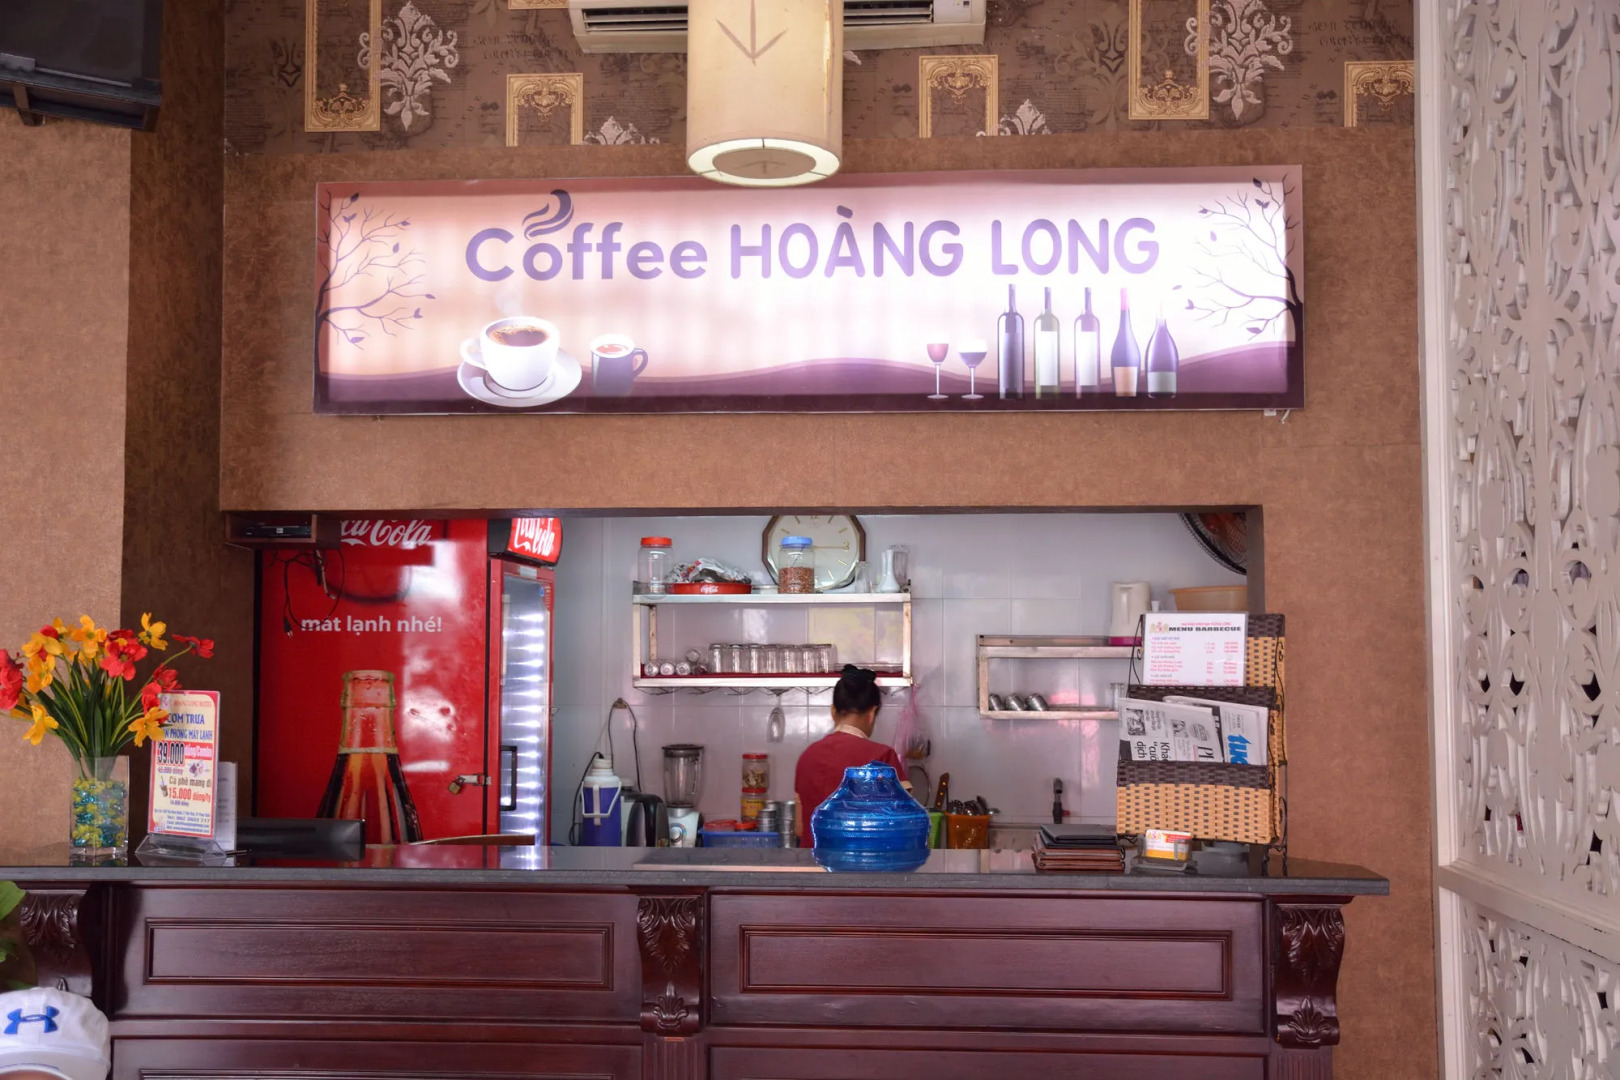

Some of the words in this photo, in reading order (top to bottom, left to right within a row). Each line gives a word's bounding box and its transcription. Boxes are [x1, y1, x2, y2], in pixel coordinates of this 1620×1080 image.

[465, 221, 708, 282] Coffee
[730, 204, 964, 280] HOÀNG
[991, 217, 1160, 276] LONG
[346, 615, 391, 636] lạnh
[397, 615, 442, 632] nhé!
[158, 742, 184, 764] 39.000
[1135, 741, 1147, 759] dịch
[168, 787, 192, 799] 15.000
